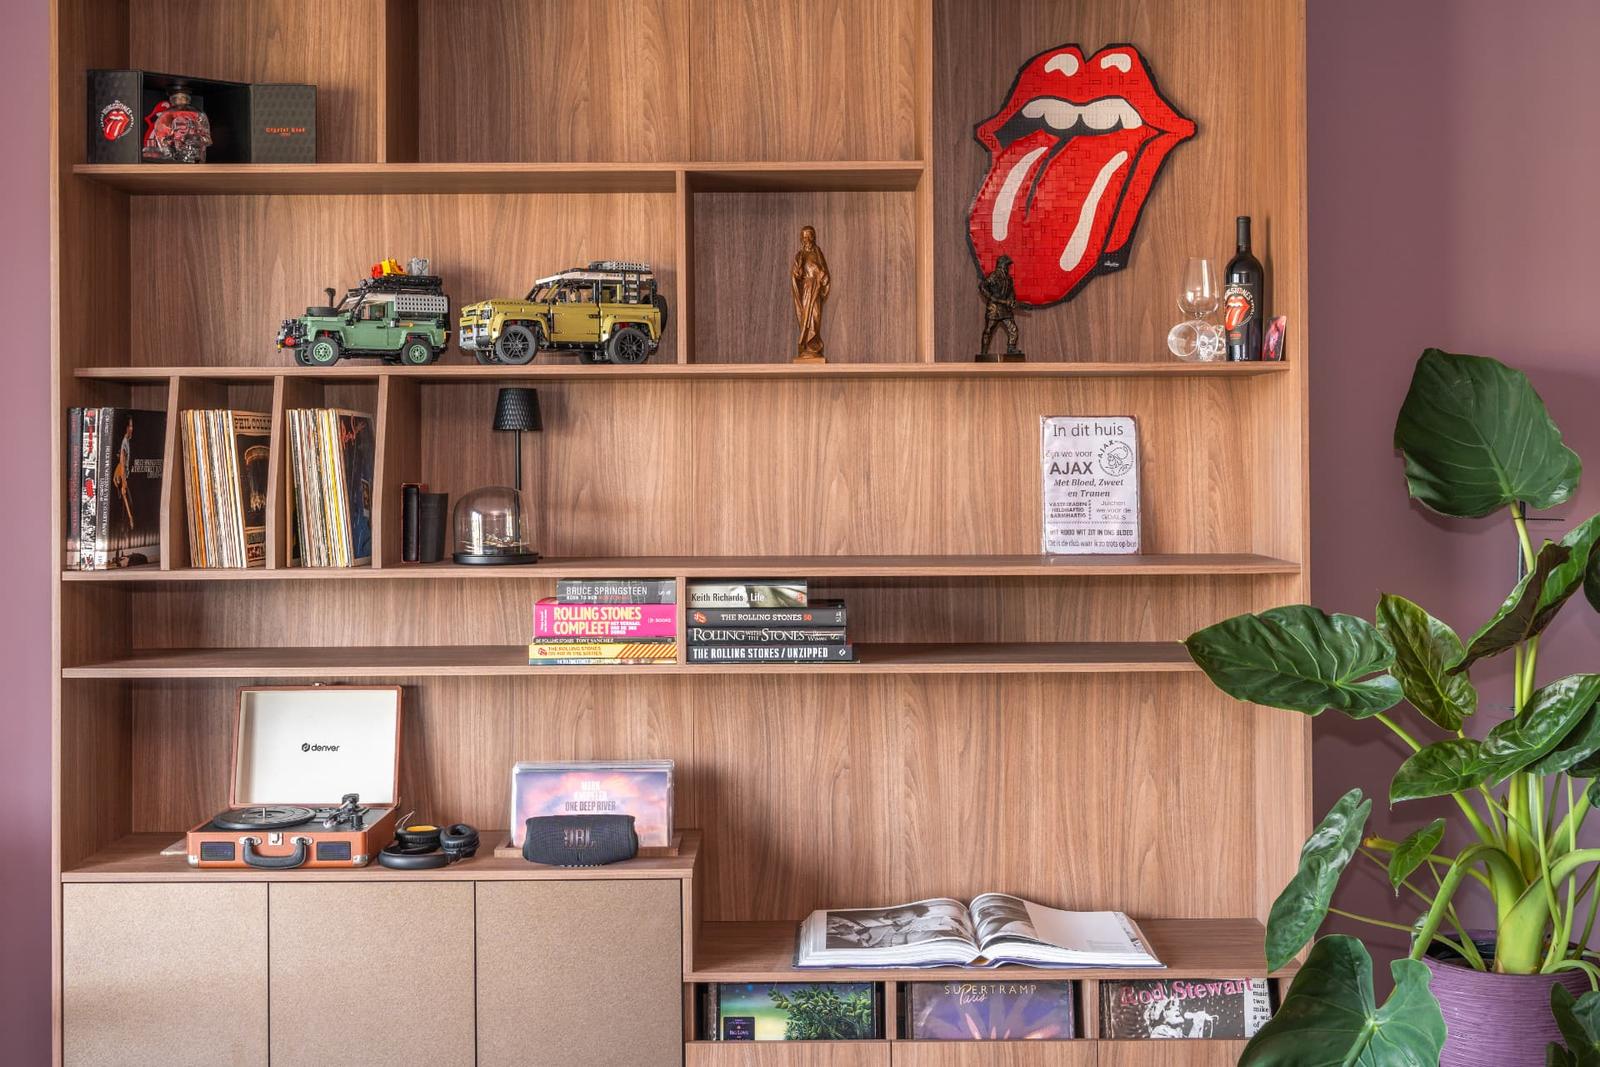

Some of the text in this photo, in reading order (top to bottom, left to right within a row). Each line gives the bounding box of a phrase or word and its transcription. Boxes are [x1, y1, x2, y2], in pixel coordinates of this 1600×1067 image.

[234, 417, 251, 430] PHIL
[1052, 422, 1124, 437] In dit huis
[1097, 439, 1114, 459] AJAX
[1049, 461, 1094, 475] AJAX
[1053, 478, 1124, 487] Met Bloed, Zweet
[1080, 490, 1111, 498] Tranen
[566, 586, 648, 596] BRUCE SPRINGSTEEN
[691, 592, 744, 602] Keith Richards
[553, 606, 600, 621] ROLLING
[600, 606, 643, 621] STONES
[553, 621, 610, 636] COMPLEET
[693, 627, 745, 642] ROLLING
[761, 627, 805, 642] STONES
[693, 647, 709, 659] THE
[711, 647, 746, 659] ROLLING
[748, 647, 780, 659] STONES
[787, 647, 828, 659] UNZIPPED
[311, 743, 341, 752] denver
[565, 800, 617, 812] ONE DEEP RIVER
[564, 827, 594, 849] JBL
[944, 984, 1037, 995] SUPERTRAMP
[1120, 976, 1254, 1007] Rod Stewart
